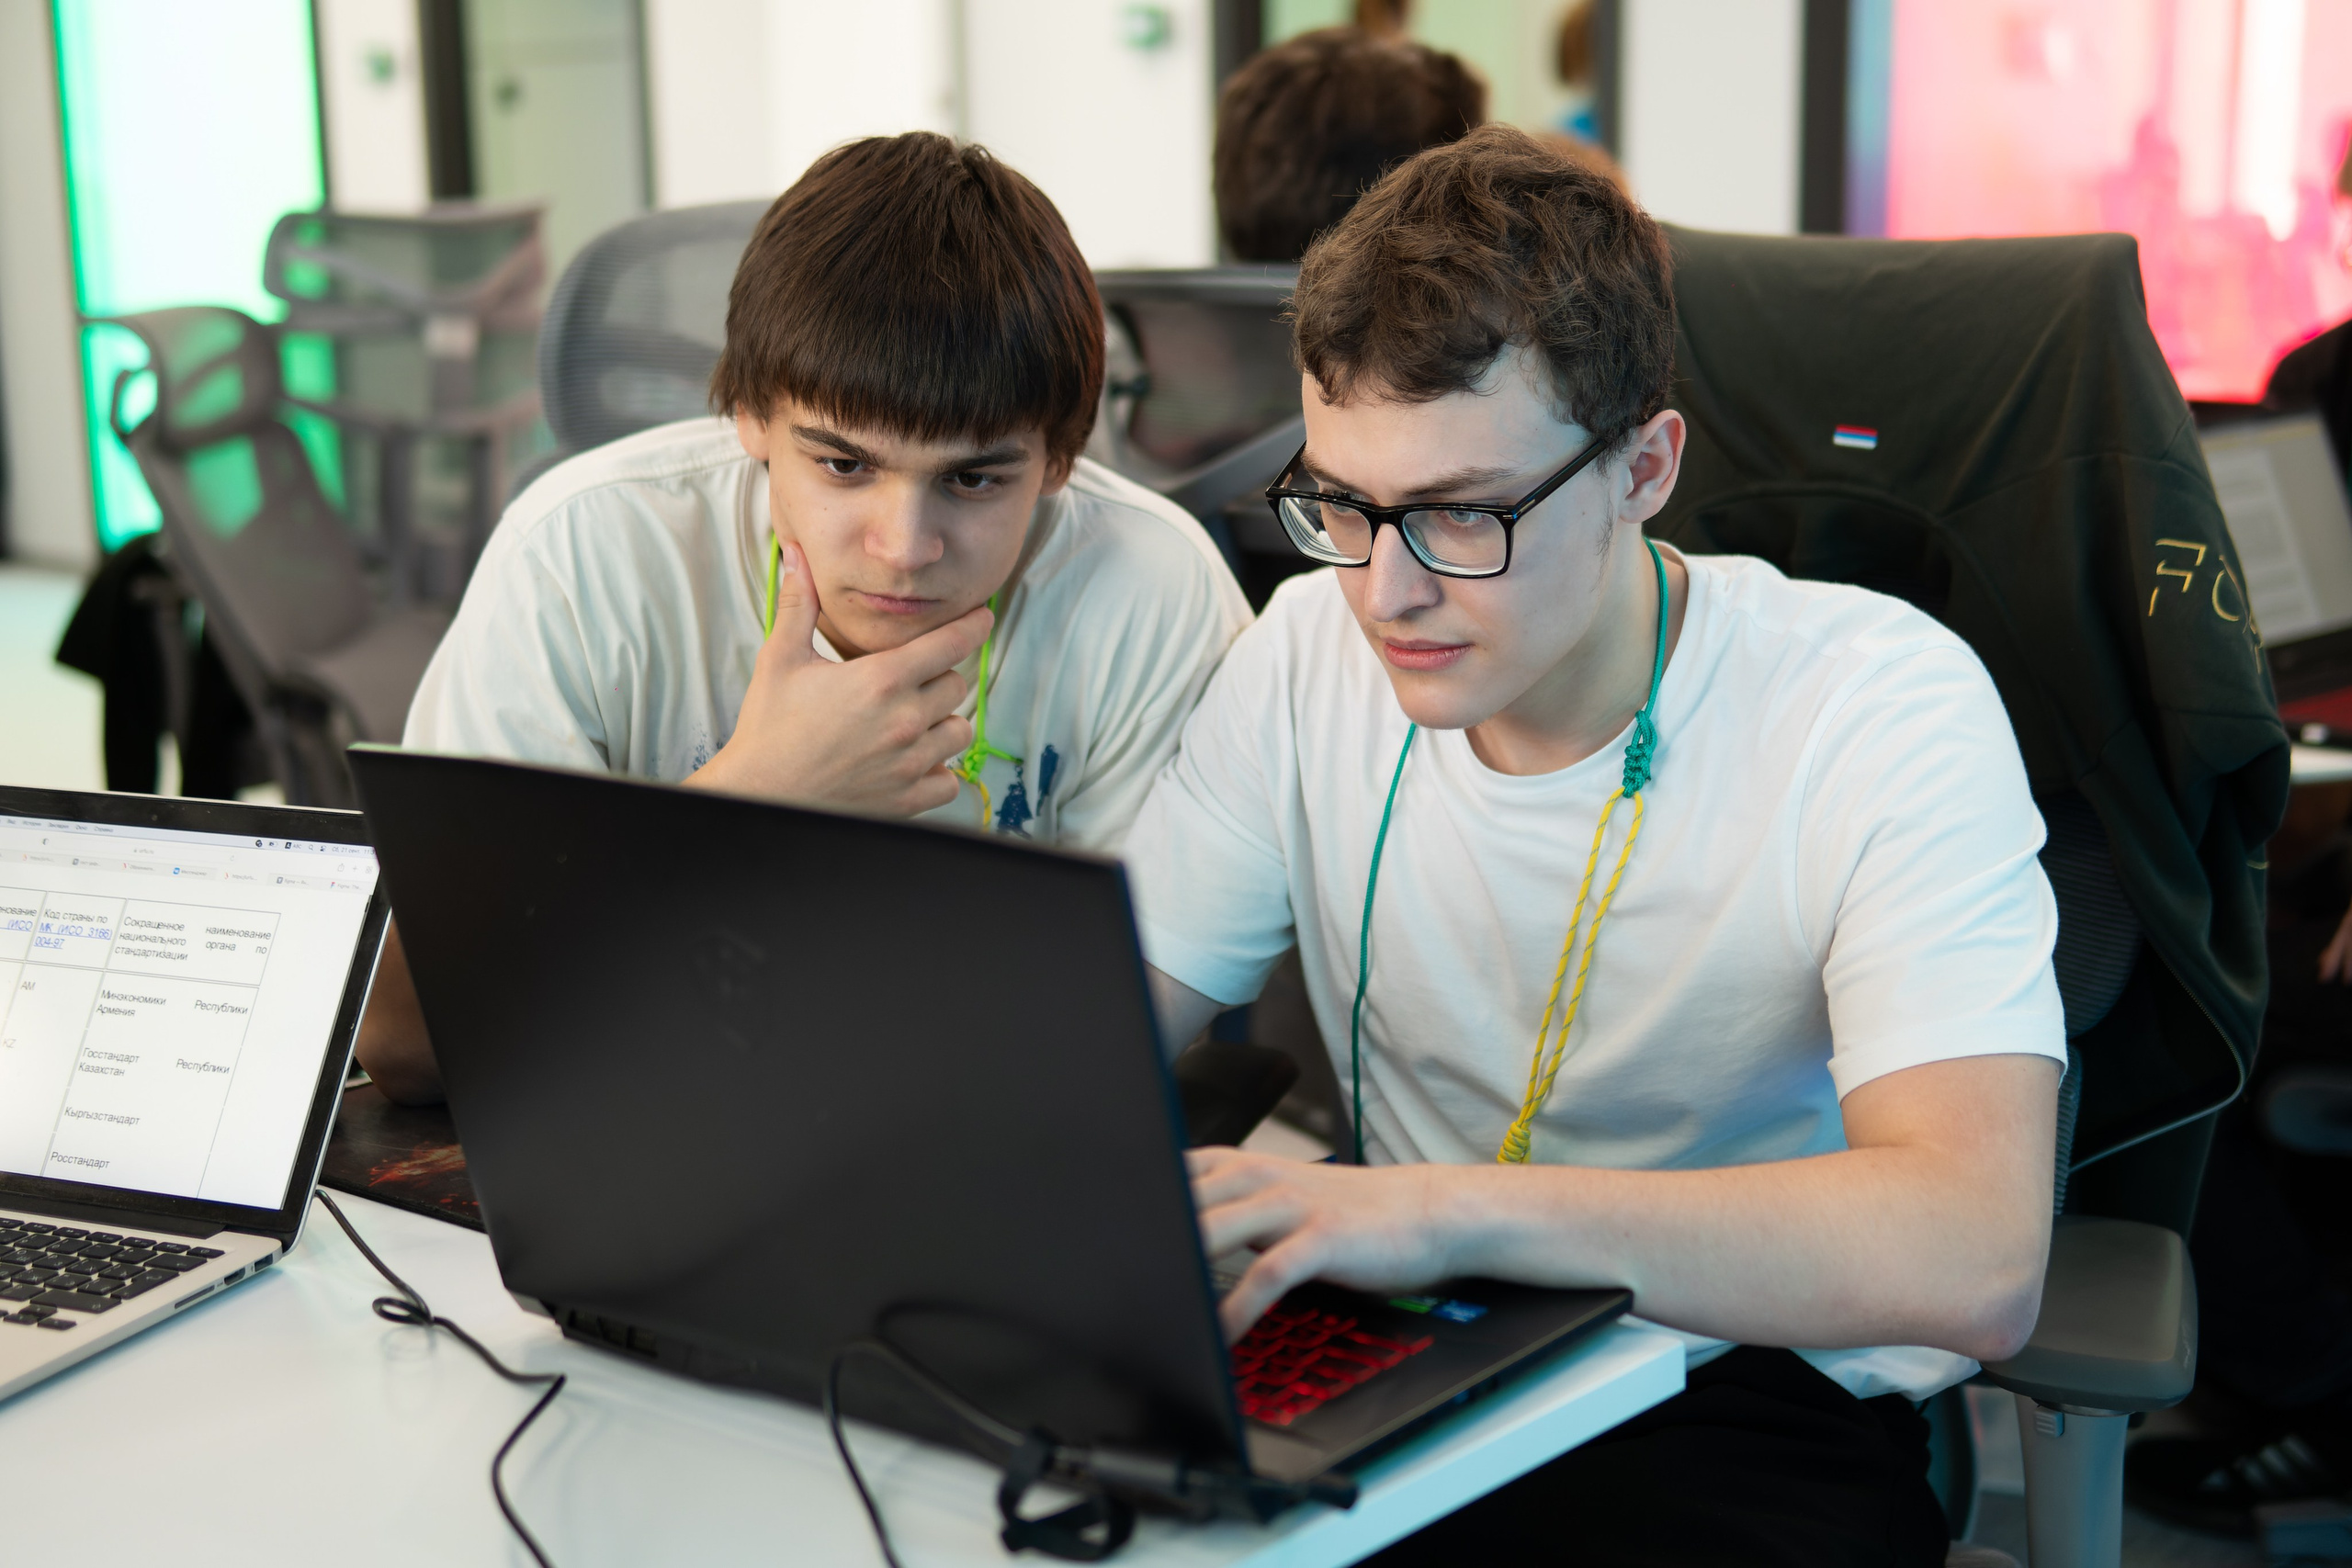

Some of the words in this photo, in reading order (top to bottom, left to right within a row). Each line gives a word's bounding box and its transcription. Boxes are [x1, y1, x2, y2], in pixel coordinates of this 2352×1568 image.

[44, 908, 60, 919] Код
[62, 912, 94, 923] страны
[96, 915, 108, 924] по
[123, 916, 186, 931] Сокращенное
[205, 926, 272, 941] наименование
[119, 932, 187, 946] национального
[205, 941, 237, 952] органа
[255, 945, 268, 954] по
[115, 946, 188, 961] стандартизации
[96, 1004, 136, 1017] Армения
[100, 989, 167, 1006] Минэкономики
[194, 999, 249, 1015] Республики
[78, 1062, 126, 1077] Казахстан
[82, 1047, 140, 1064] Госстандарт
[175, 1058, 231, 1075] Республики
[64, 1106, 141, 1126] Кыргызстандарт
[51, 1151, 110, 1169] Росстандарт
